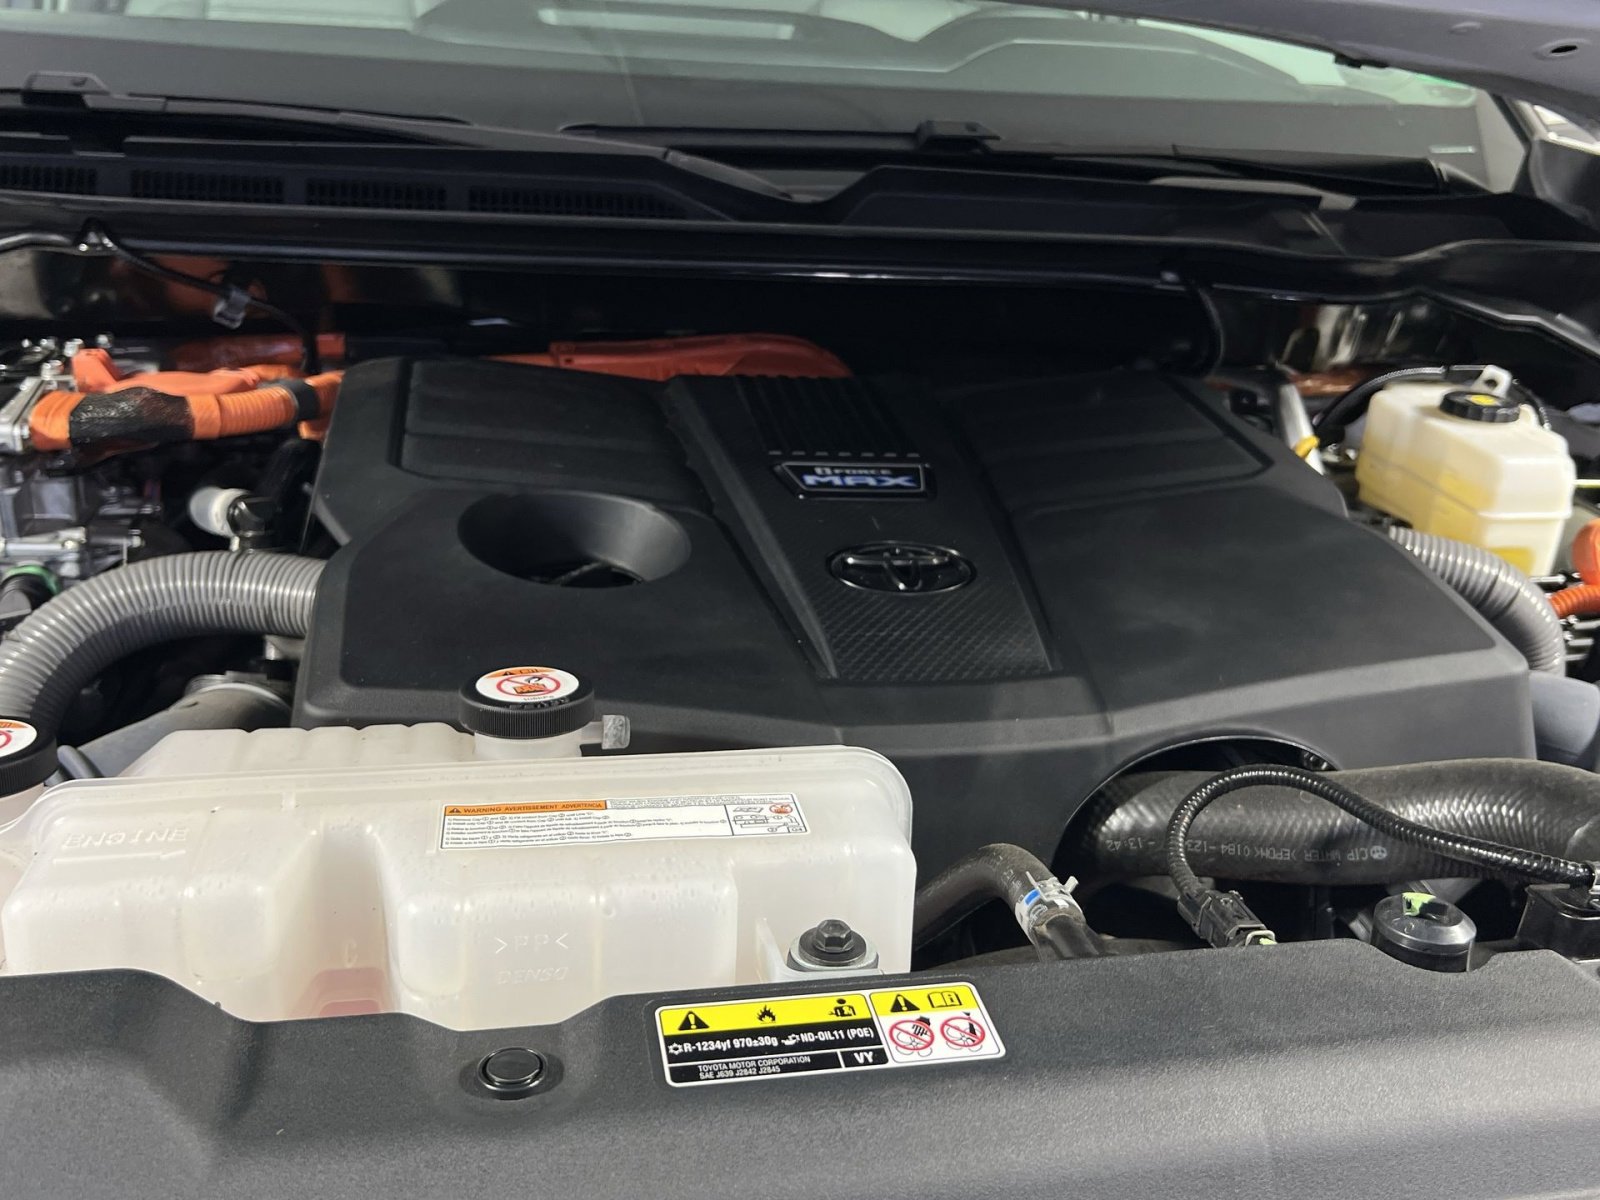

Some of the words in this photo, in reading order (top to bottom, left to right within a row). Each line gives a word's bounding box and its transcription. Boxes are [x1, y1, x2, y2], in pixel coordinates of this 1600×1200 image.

[803, 475, 917, 487] MAX
[463, 806, 501, 814] WARNING
[504, 804, 558, 812] AVERTISSEMENT
[561, 802, 602, 810] ADVERTENCIA
[683, 1040, 731, 1053] R-1234yf
[733, 1036, 778, 1049] 970±30g
[801, 1029, 845, 1043] ND-OIL11
[847, 1027, 875, 1040] (POE)
[698, 1064, 727, 1072] TOYOTA
[729, 1060, 757, 1070] MOTOR
[757, 1055, 811, 1068] CORPORATION
[854, 1051, 875, 1064] VY
[699, 1072, 715, 1080] SAE
[716, 1069, 734, 1078] J639
[735, 1067, 758, 1077] J2842
[758, 1065, 781, 1075] J2845
